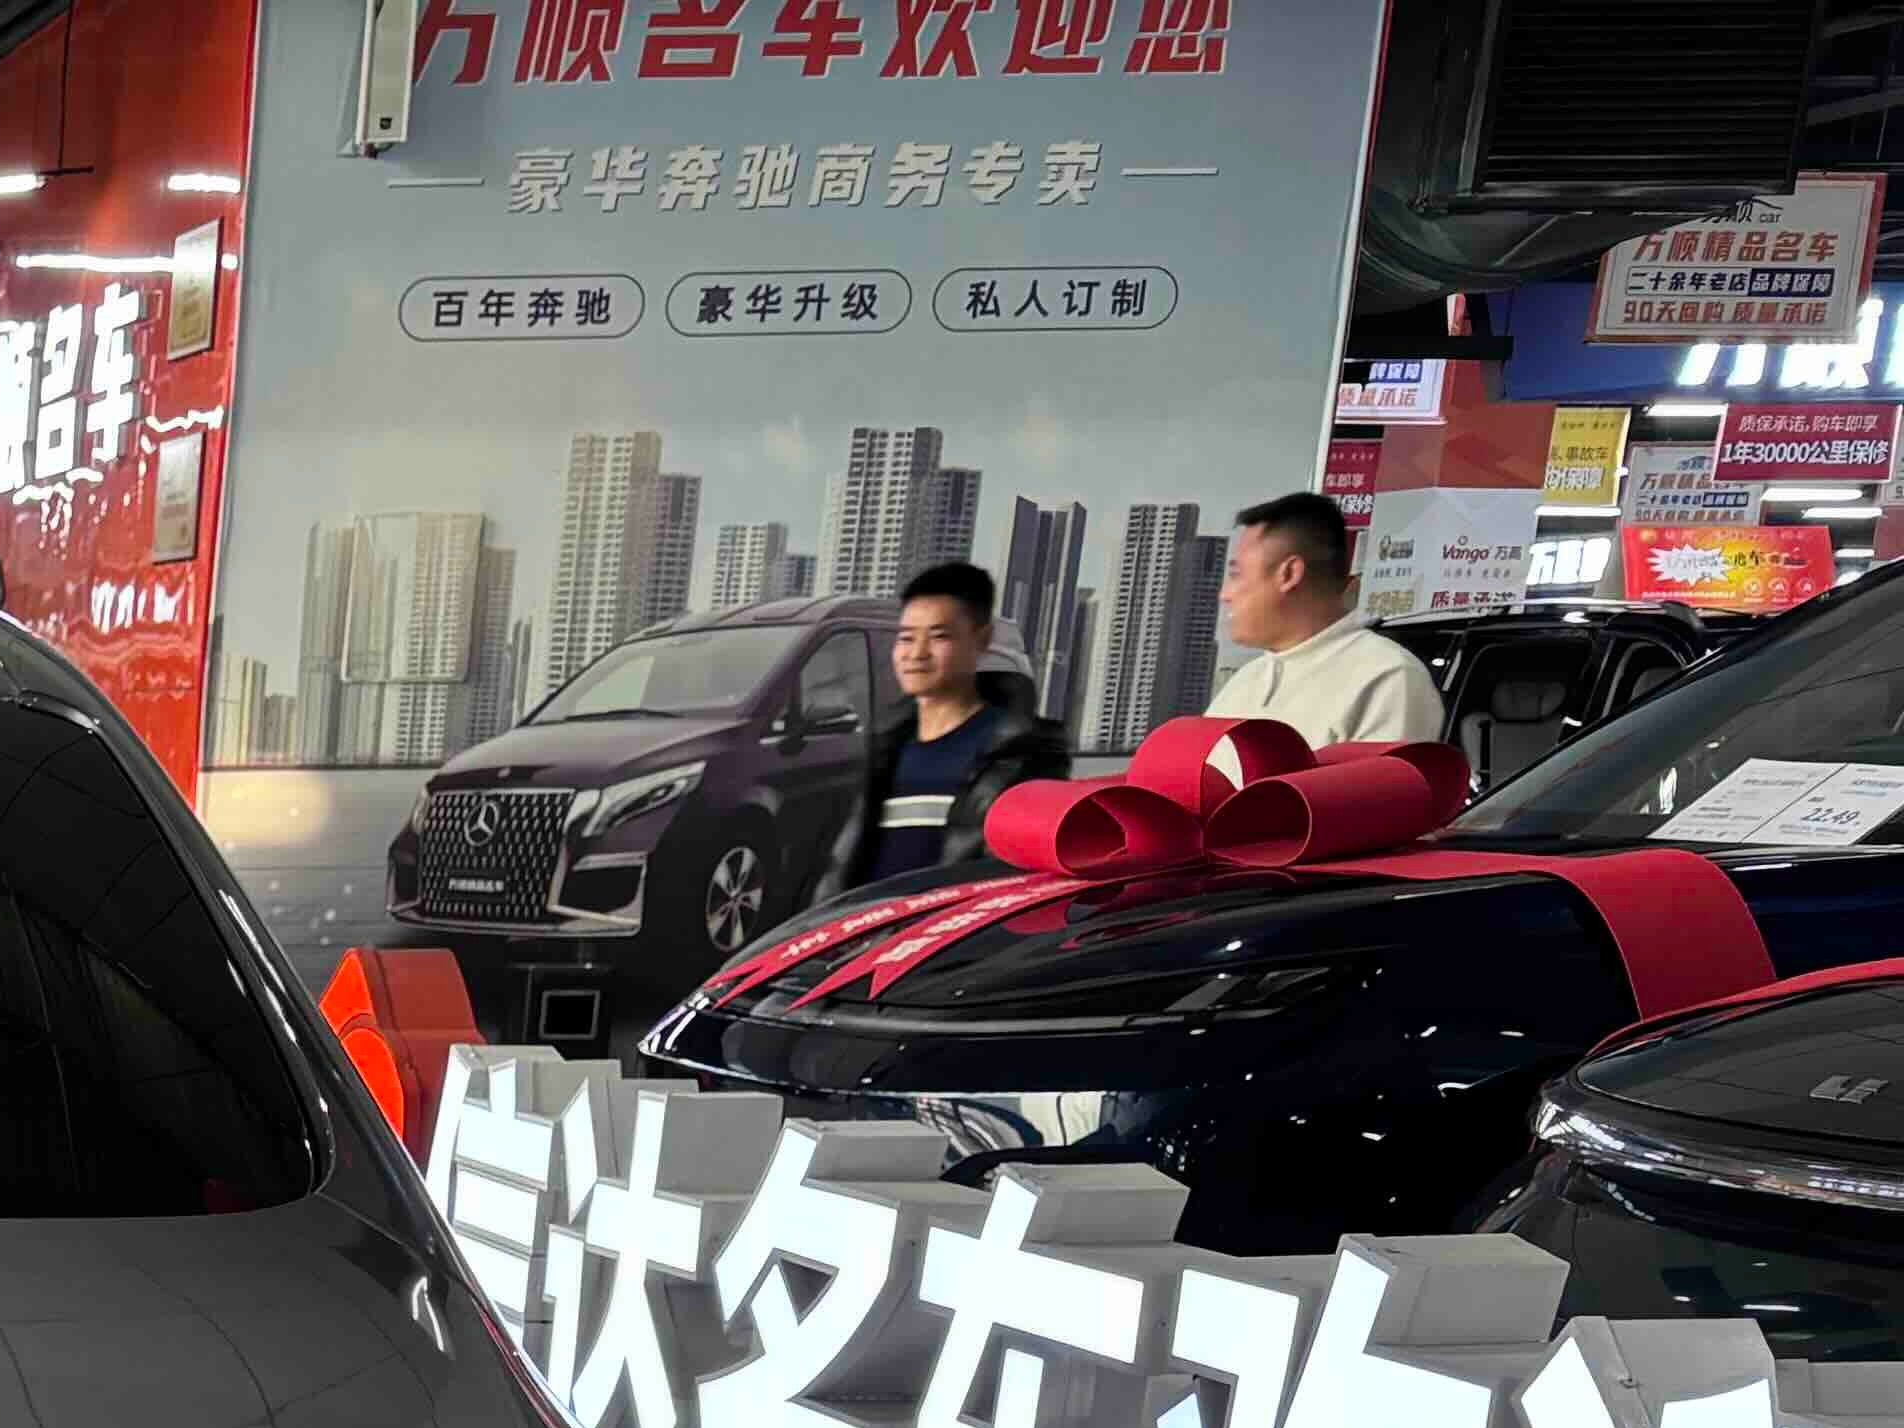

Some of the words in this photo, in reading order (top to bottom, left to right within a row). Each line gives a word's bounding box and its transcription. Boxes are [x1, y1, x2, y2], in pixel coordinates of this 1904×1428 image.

[506, 143, 1104, 215] 豪华奔驰商务专卖
[1632, 230, 1840, 263] 万顺精品名车
[432, 286, 614, 329] 百年奔驰
[695, 282, 882, 326] 豪华升级
[965, 279, 1149, 321] 私人订制
[1721, 439, 1889, 465] 1年30000公里保修
